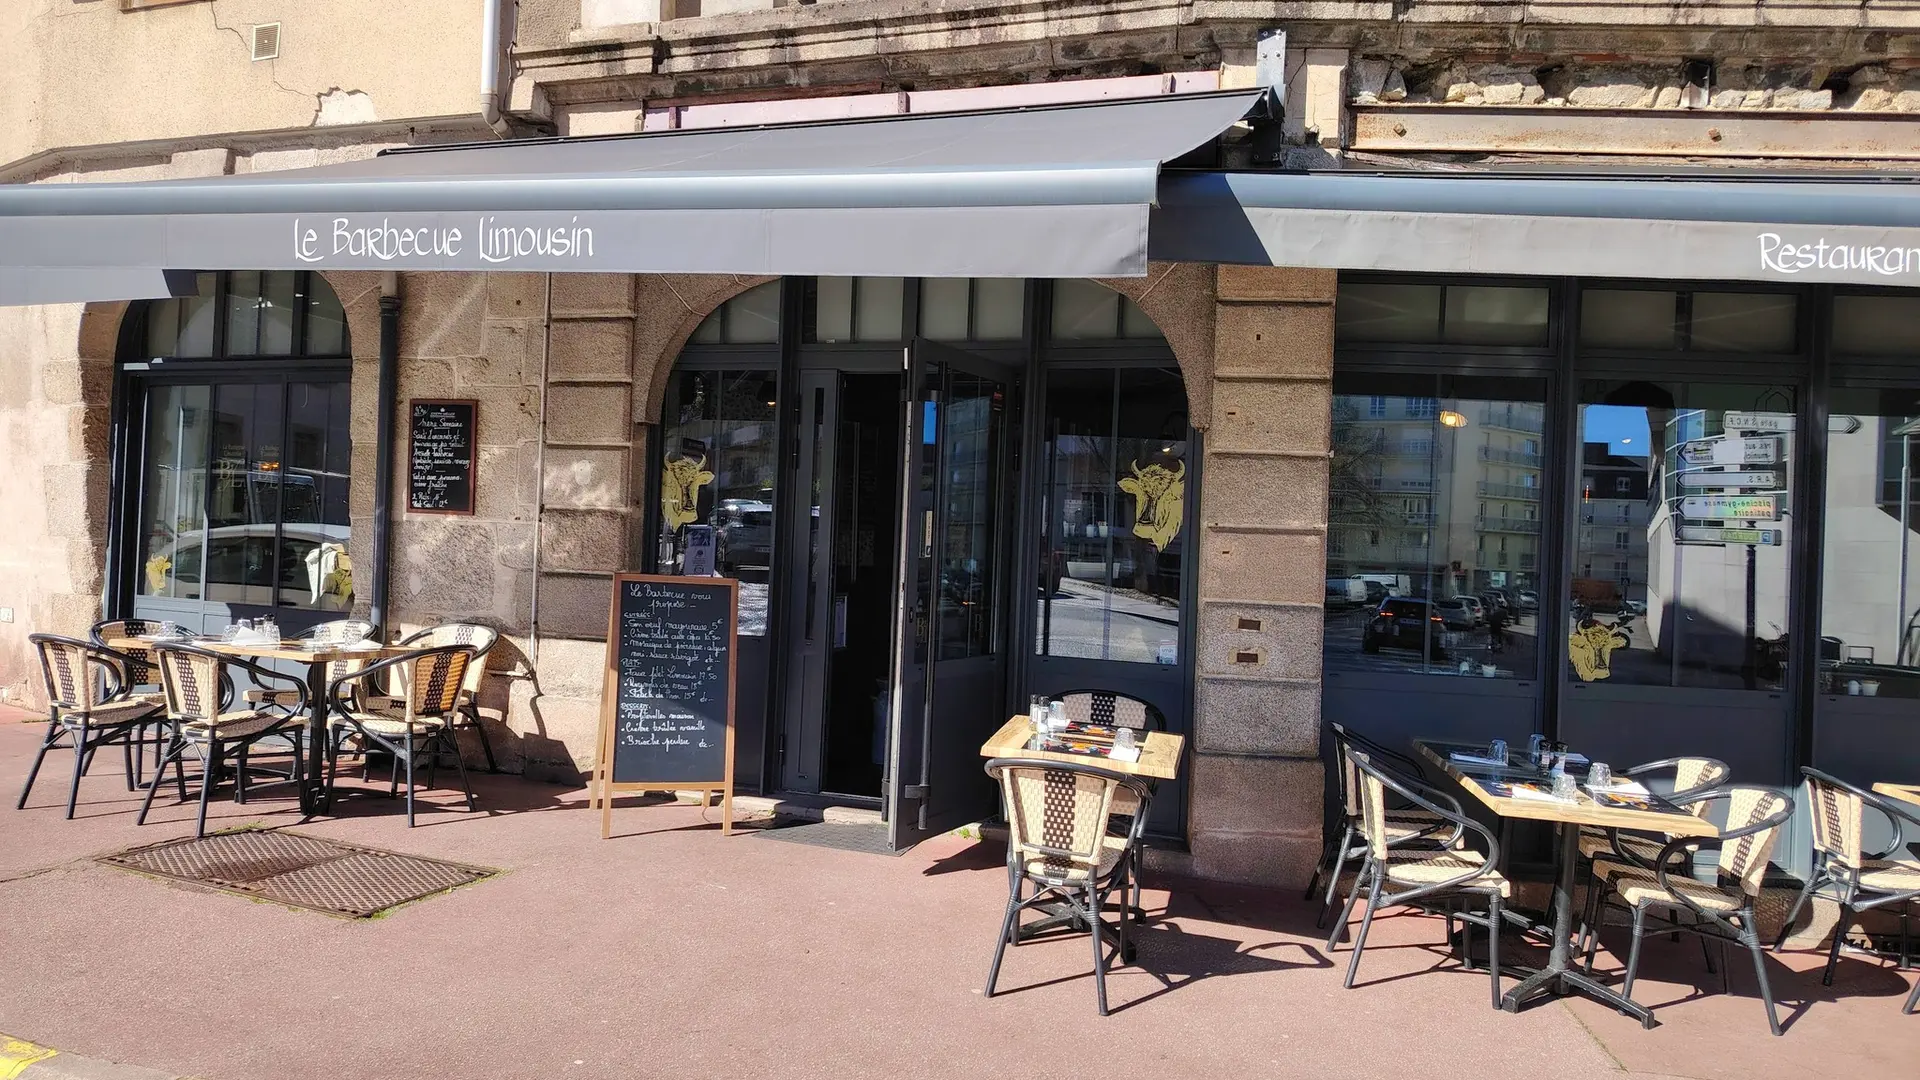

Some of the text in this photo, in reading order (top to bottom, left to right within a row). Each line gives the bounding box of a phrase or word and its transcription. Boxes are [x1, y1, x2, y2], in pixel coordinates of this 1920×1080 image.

[294, 215, 594, 263] Le Barbecue Limousin
[630, 583, 711, 600] Le Barbecue vous
[648, 599, 686, 617] propose
